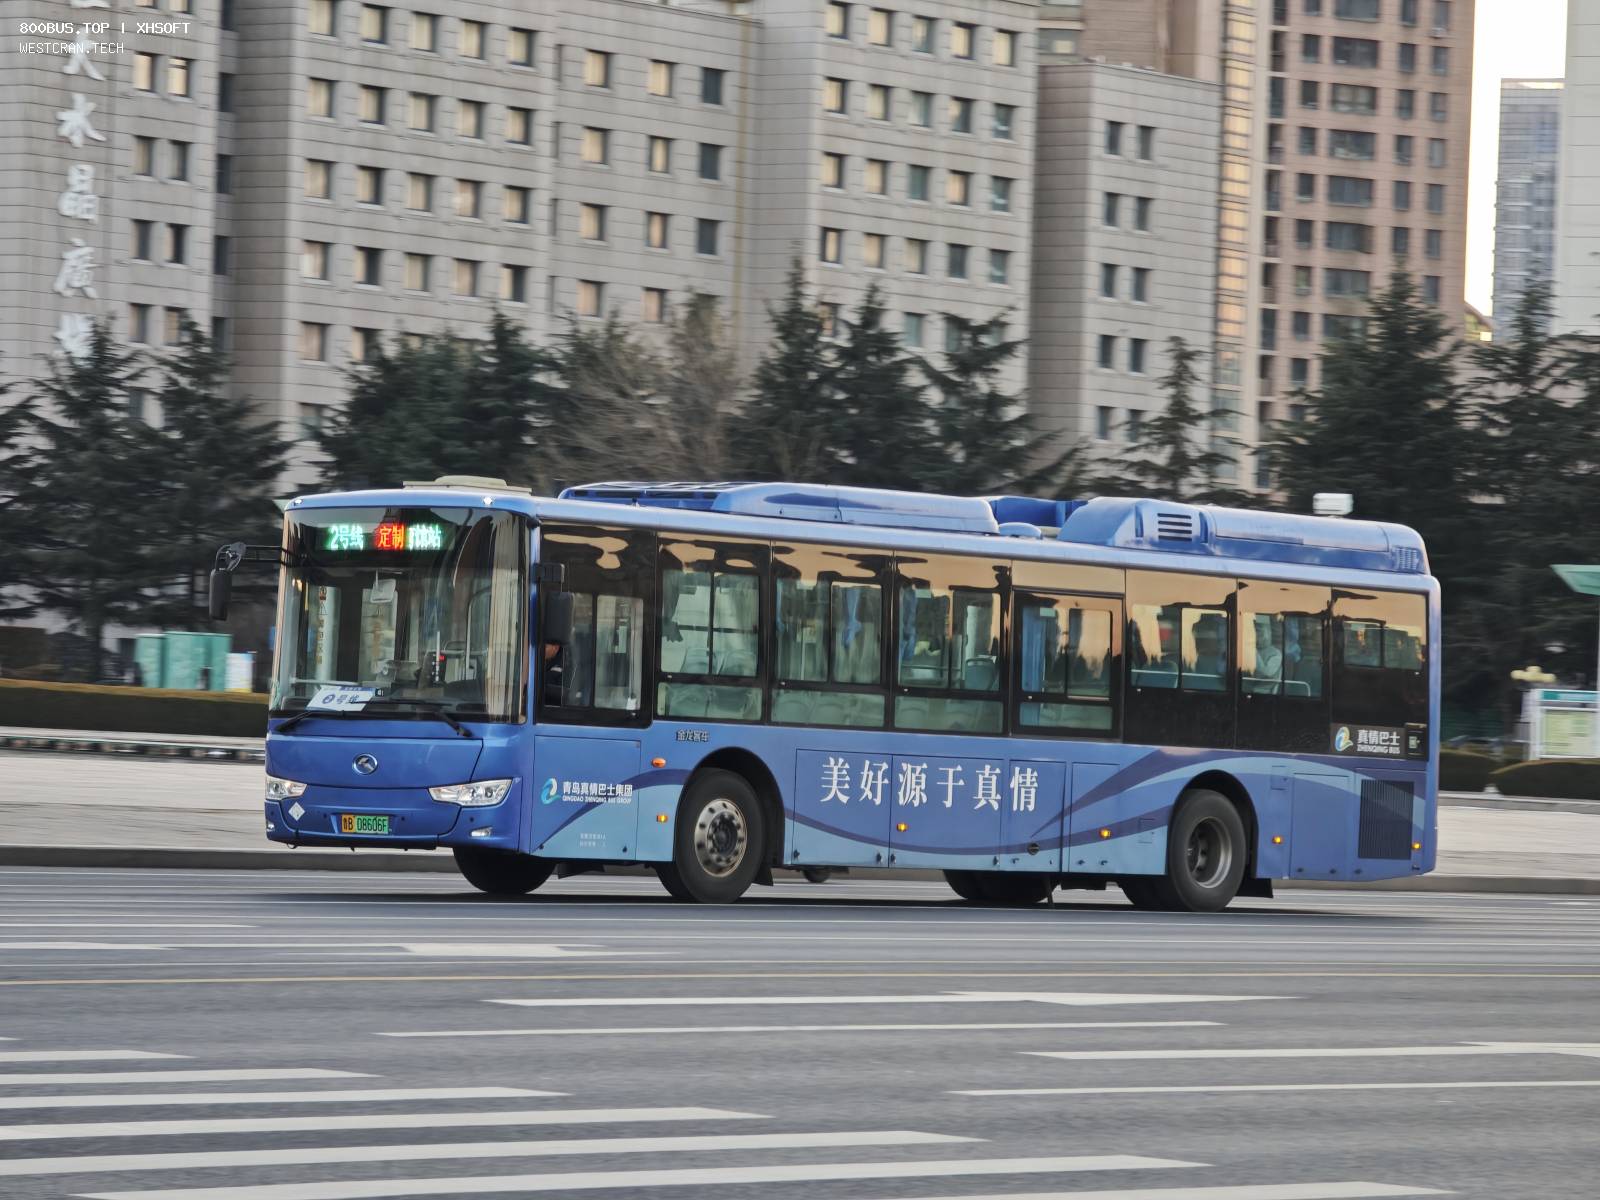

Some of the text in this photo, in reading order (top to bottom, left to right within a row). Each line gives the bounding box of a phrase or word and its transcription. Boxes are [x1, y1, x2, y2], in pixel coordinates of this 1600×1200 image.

[330, 524, 364, 550] 2号线
[377, 524, 405, 549] 定制
[1357, 729, 1400, 746] 真情巴士
[563, 781, 633, 797] 青岛真情巴士集团
[819, 756, 1039, 812] 美好源于真情
